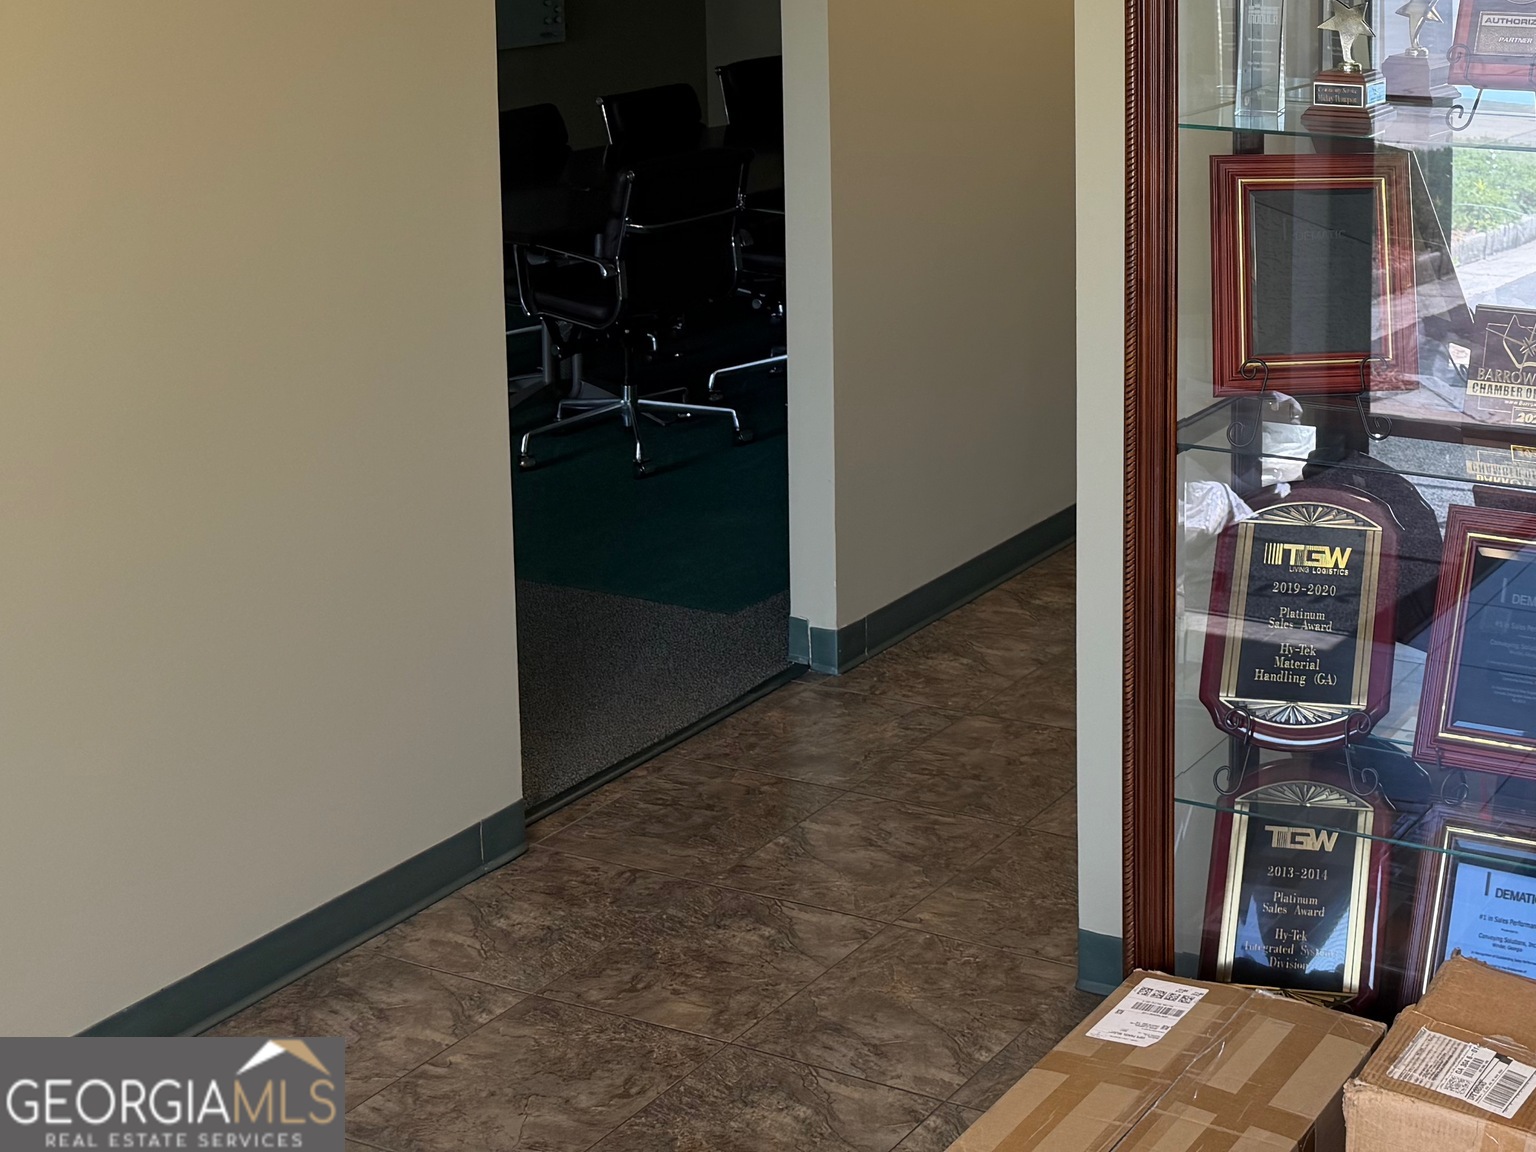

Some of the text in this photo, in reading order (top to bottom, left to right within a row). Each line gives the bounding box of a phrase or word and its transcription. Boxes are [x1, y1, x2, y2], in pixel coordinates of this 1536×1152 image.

[1498, 36, 1534, 45] PARTNER
[1476, 367, 1536, 386] BARROW
[1472, 382, 1524, 399] CHAMBER
[1283, 543, 1353, 569] TGW
[1312, 567, 1349, 576] LOGISTICS
[1272, 581, 1337, 597] 2019-2020
[1279, 607, 1326, 621] Platinum
[1268, 617, 1333, 632] Sales Award
[1280, 642, 1317, 658] Hy-Tek
[1274, 656, 1320, 671] Material
[1254, 669, 1338, 688] Handling (GA)
[1264, 825, 1339, 852] TGW
[1267, 865, 1328, 881] 2013-2014
[1273, 891, 1318, 906] Platinum
[1262, 903, 1325, 918] Sales Award
[1494, 916, 1509, 925] Sales
[1274, 928, 1308, 944] Hy-Tek
[1478, 932, 1504, 944] Conveying
[1244, 941, 1295, 955] Integrated
[1269, 956, 1309, 970] Division
